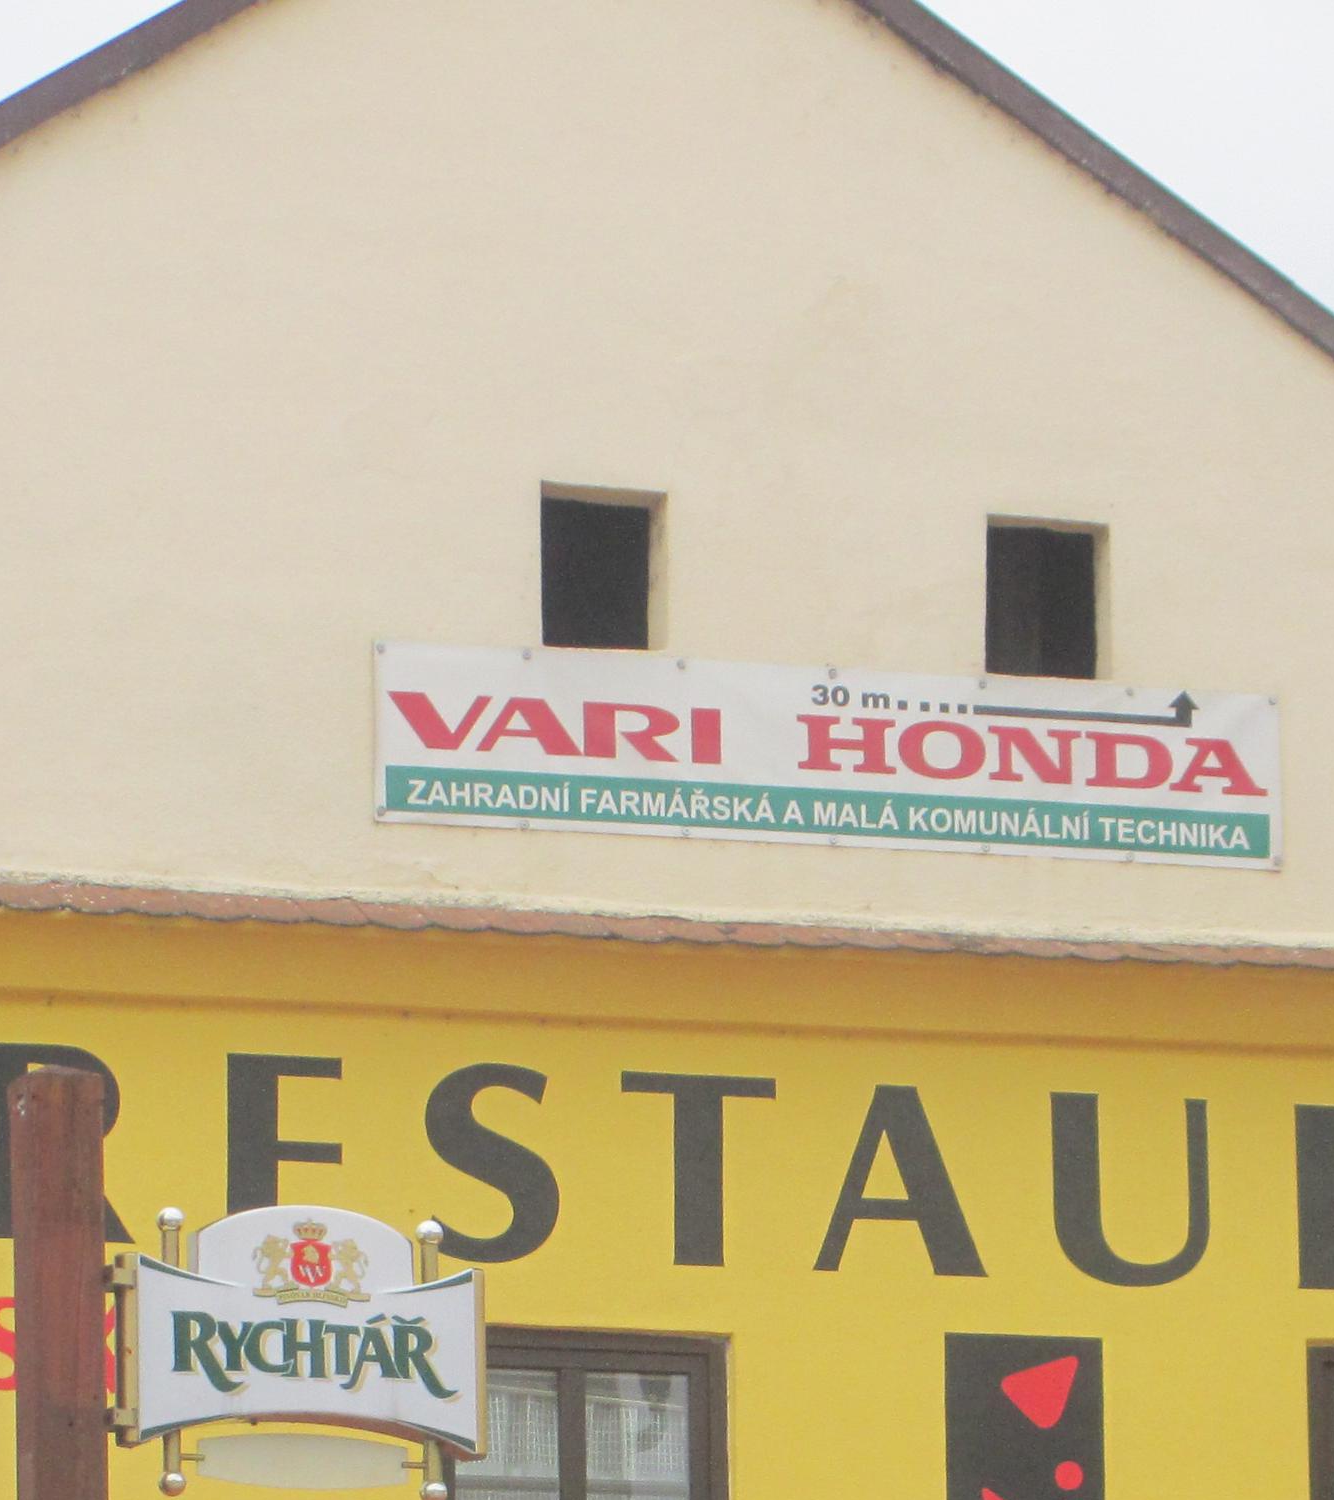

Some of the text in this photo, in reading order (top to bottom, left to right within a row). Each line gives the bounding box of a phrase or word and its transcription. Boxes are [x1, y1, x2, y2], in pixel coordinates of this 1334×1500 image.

[811, 684, 850, 707] 30
[388, 690, 1269, 797] VARI HONDA
[407, 778, 1251, 851] ZAHRADNÍ FARMÁŘSKÁ A MALÁ KOMUNÁLNÍ TECHNIKA
[171, 1310, 461, 1401] RYCHTÁŘ
